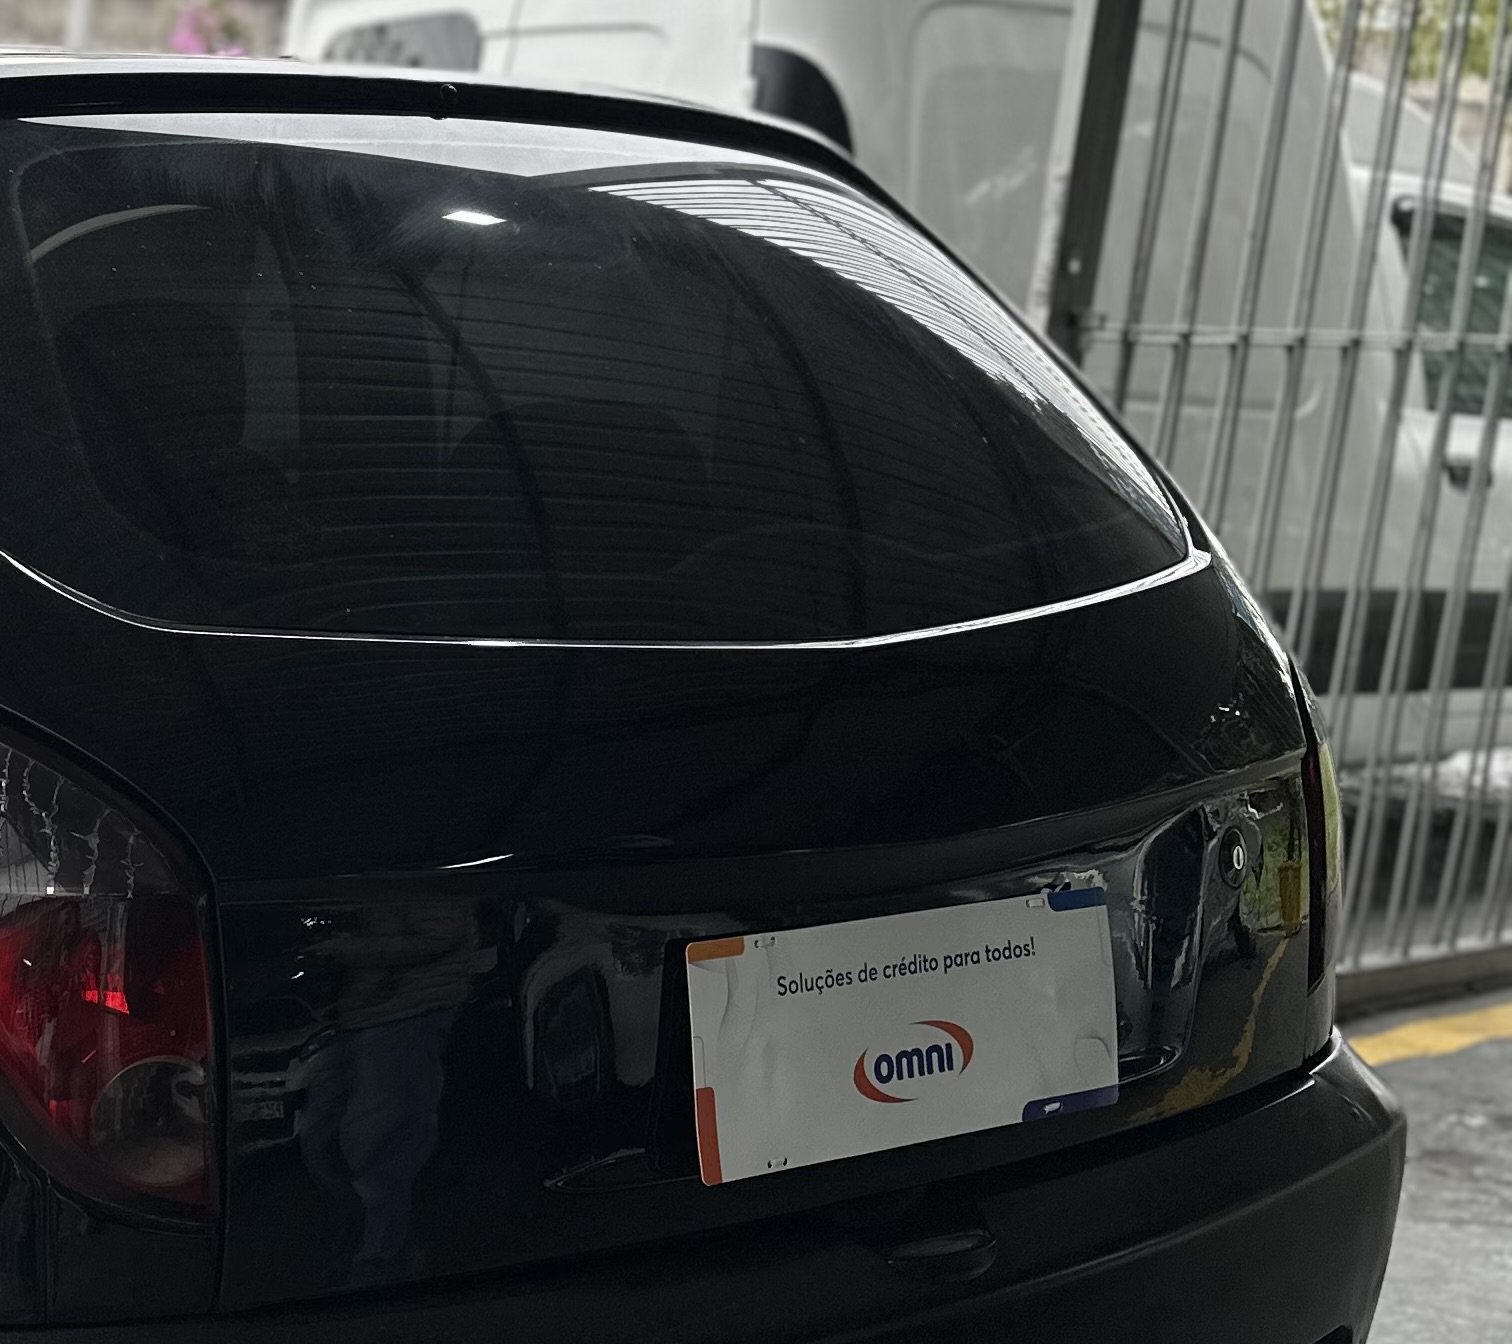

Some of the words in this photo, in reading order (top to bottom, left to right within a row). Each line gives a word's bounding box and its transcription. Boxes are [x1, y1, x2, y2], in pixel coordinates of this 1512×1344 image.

[776, 968, 853, 997] Soluções
[857, 962, 878, 984] de
[882, 953, 939, 979] crédito
[943, 948, 980, 974] para
[984, 936, 1037, 964] todos!
[873, 1042, 955, 1085] omni
